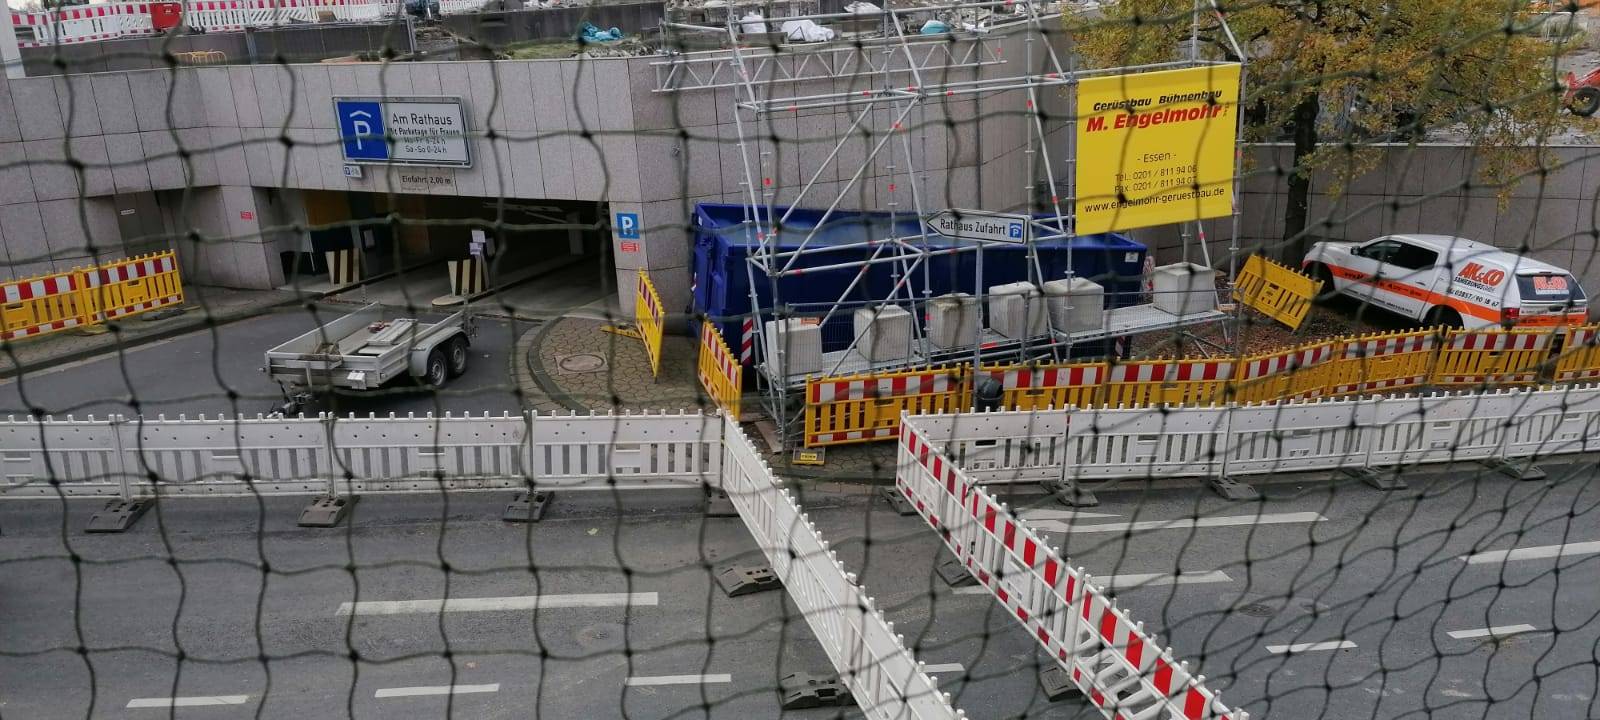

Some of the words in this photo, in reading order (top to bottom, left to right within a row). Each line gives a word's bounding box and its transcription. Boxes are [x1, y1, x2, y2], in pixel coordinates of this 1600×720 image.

[1093, 97, 1152, 111] Gerüstbau
[1158, 90, 1222, 104] Bühnenbau
[392, 113, 409, 125] Am
[410, 113, 453, 125] Rathaus
[1086, 117, 1109, 132] M.
[1113, 105, 1222, 129] Engelmohr
[1143, 151, 1171, 163] Essen
[1133, 171, 1151, 180] 0201
[1160, 167, 1174, 176] 811
[1176, 166, 1186, 174] 94
[1133, 182, 1151, 191] 0201
[1160, 179, 1174, 187] 811
[1176, 177, 1185, 185] 94
[1084, 187, 1225, 213] www.engelmohr-geruestbau.de
[940, 218, 973, 232] Rathaus
[975, 222, 1006, 235] Zufahrt
